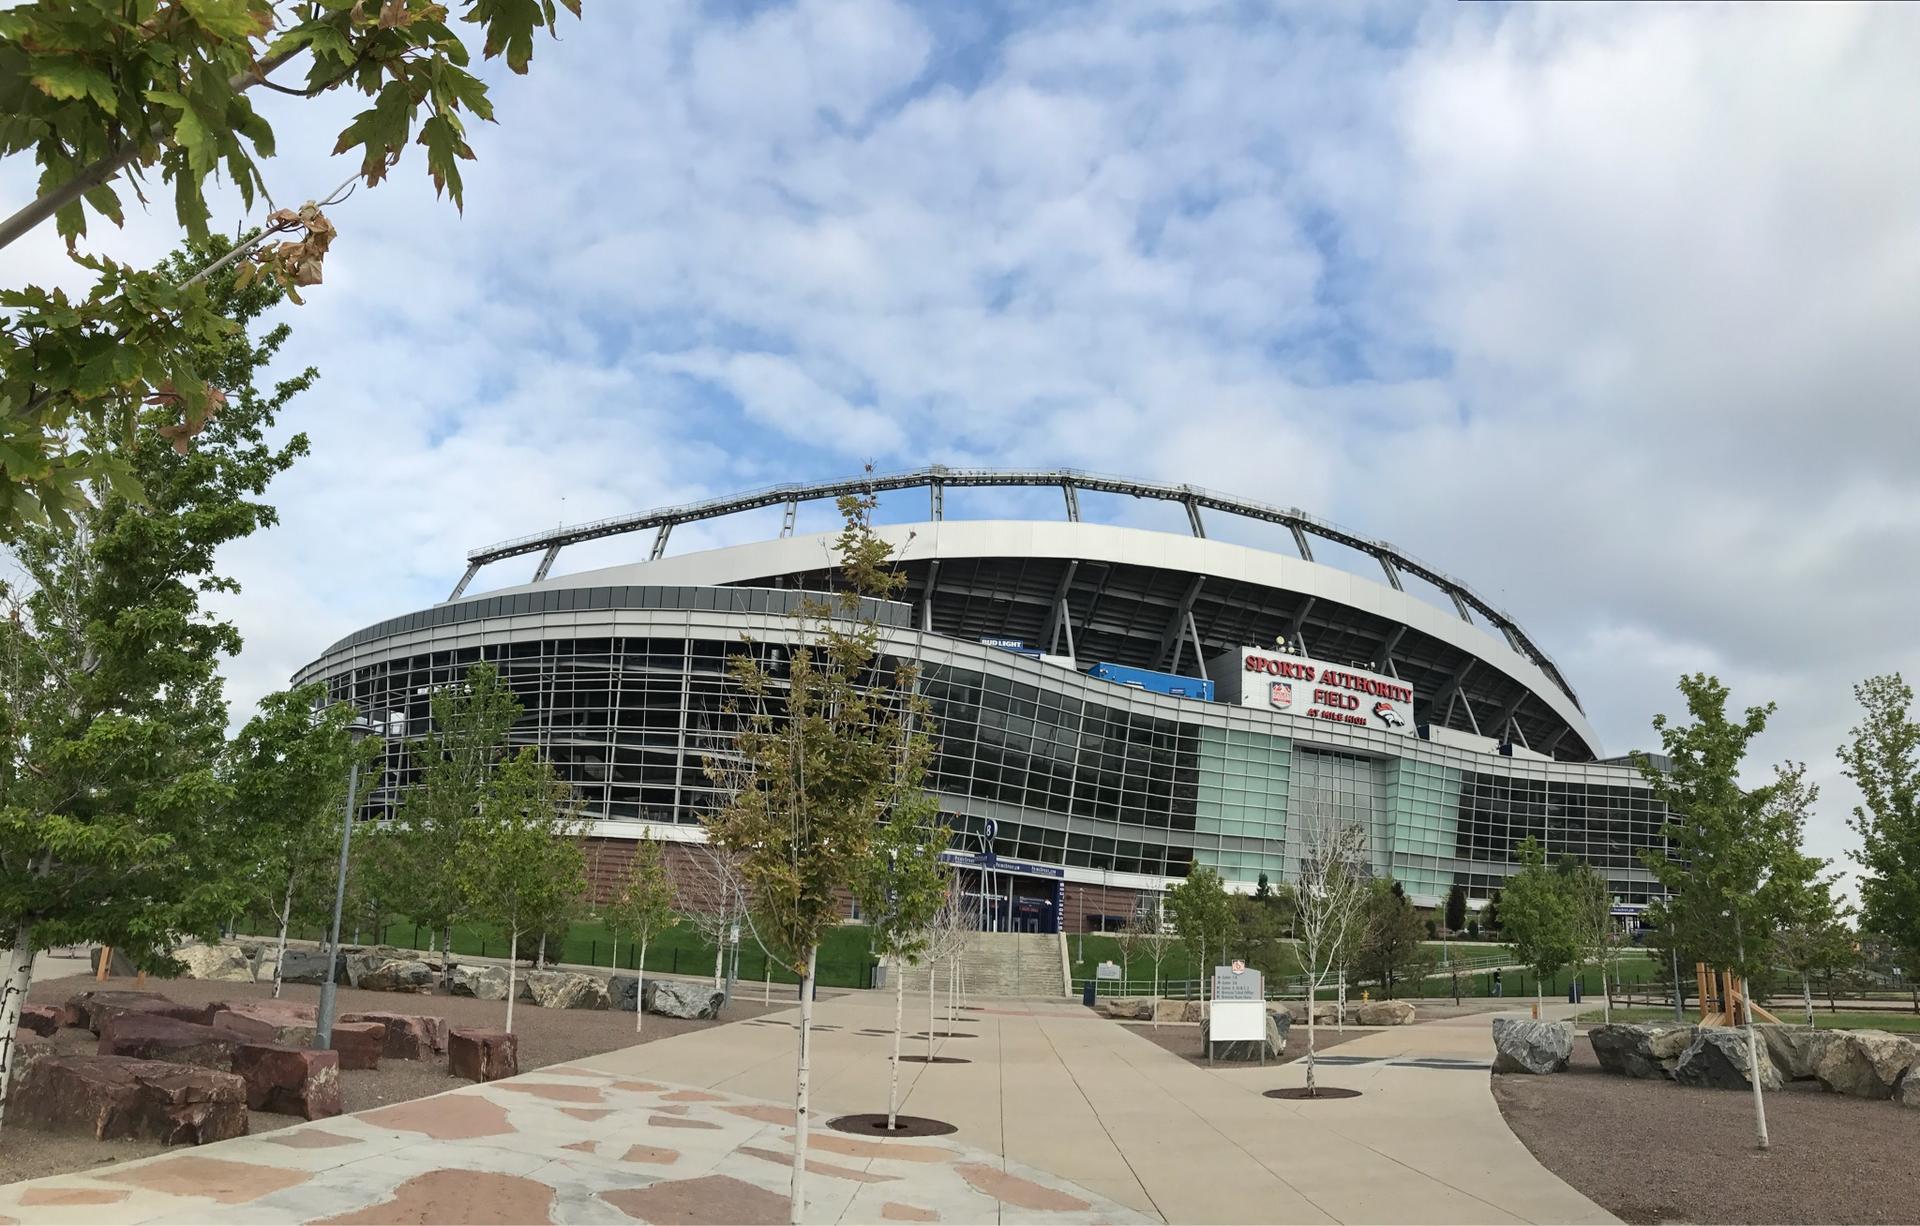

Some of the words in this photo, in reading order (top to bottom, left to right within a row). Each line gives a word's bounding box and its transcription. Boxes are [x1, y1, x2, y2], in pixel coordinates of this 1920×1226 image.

[998, 640, 1021, 648] LIGHT
[1245, 655, 1315, 681] SPORTS
[1319, 669, 1412, 704] AUTHORITY
[1314, 688, 1360, 710] FIELD
[1307, 708, 1319, 717] AT
[1321, 710, 1343, 721] MILE
[1345, 714, 1367, 726] HIGH
[986, 824, 992, 836] 8
